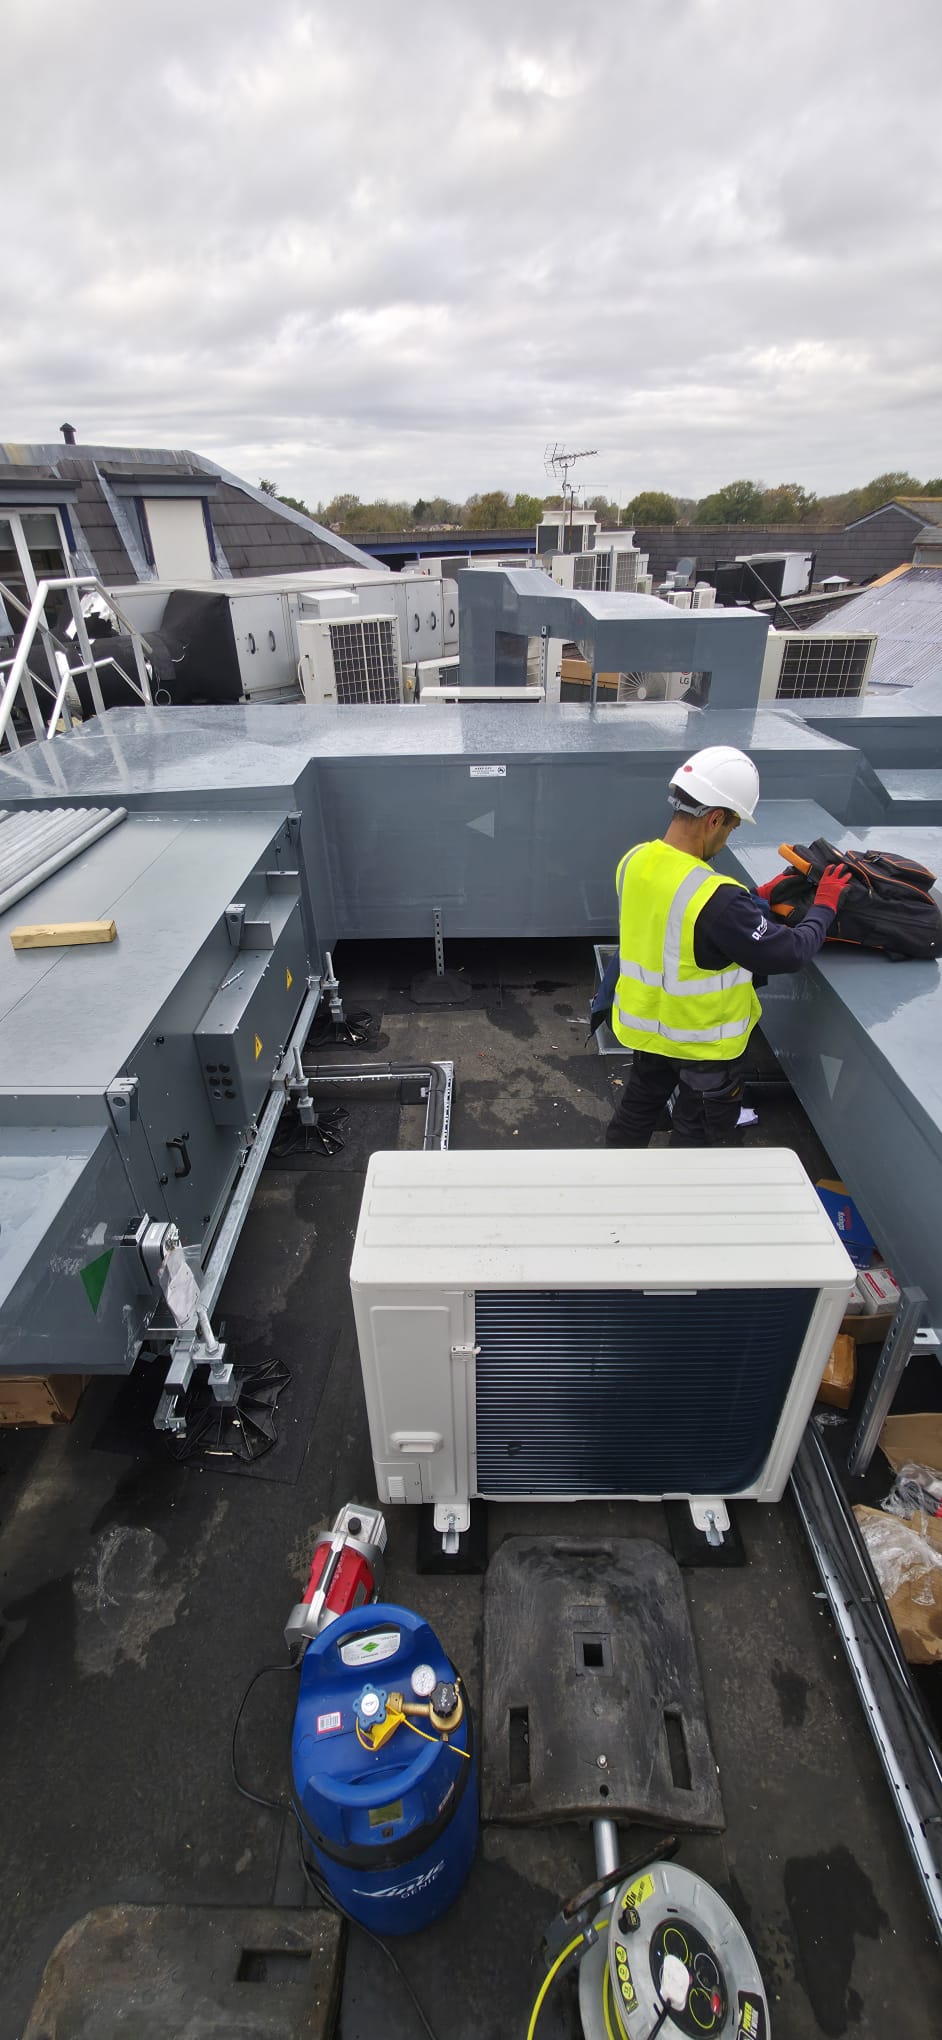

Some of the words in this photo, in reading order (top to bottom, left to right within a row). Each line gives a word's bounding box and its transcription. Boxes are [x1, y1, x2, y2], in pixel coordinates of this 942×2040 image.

[679, 677, 690, 685] LG
[401, 1873, 440, 1898] GENIE
[742, 2001, 752, 2032] POWER
